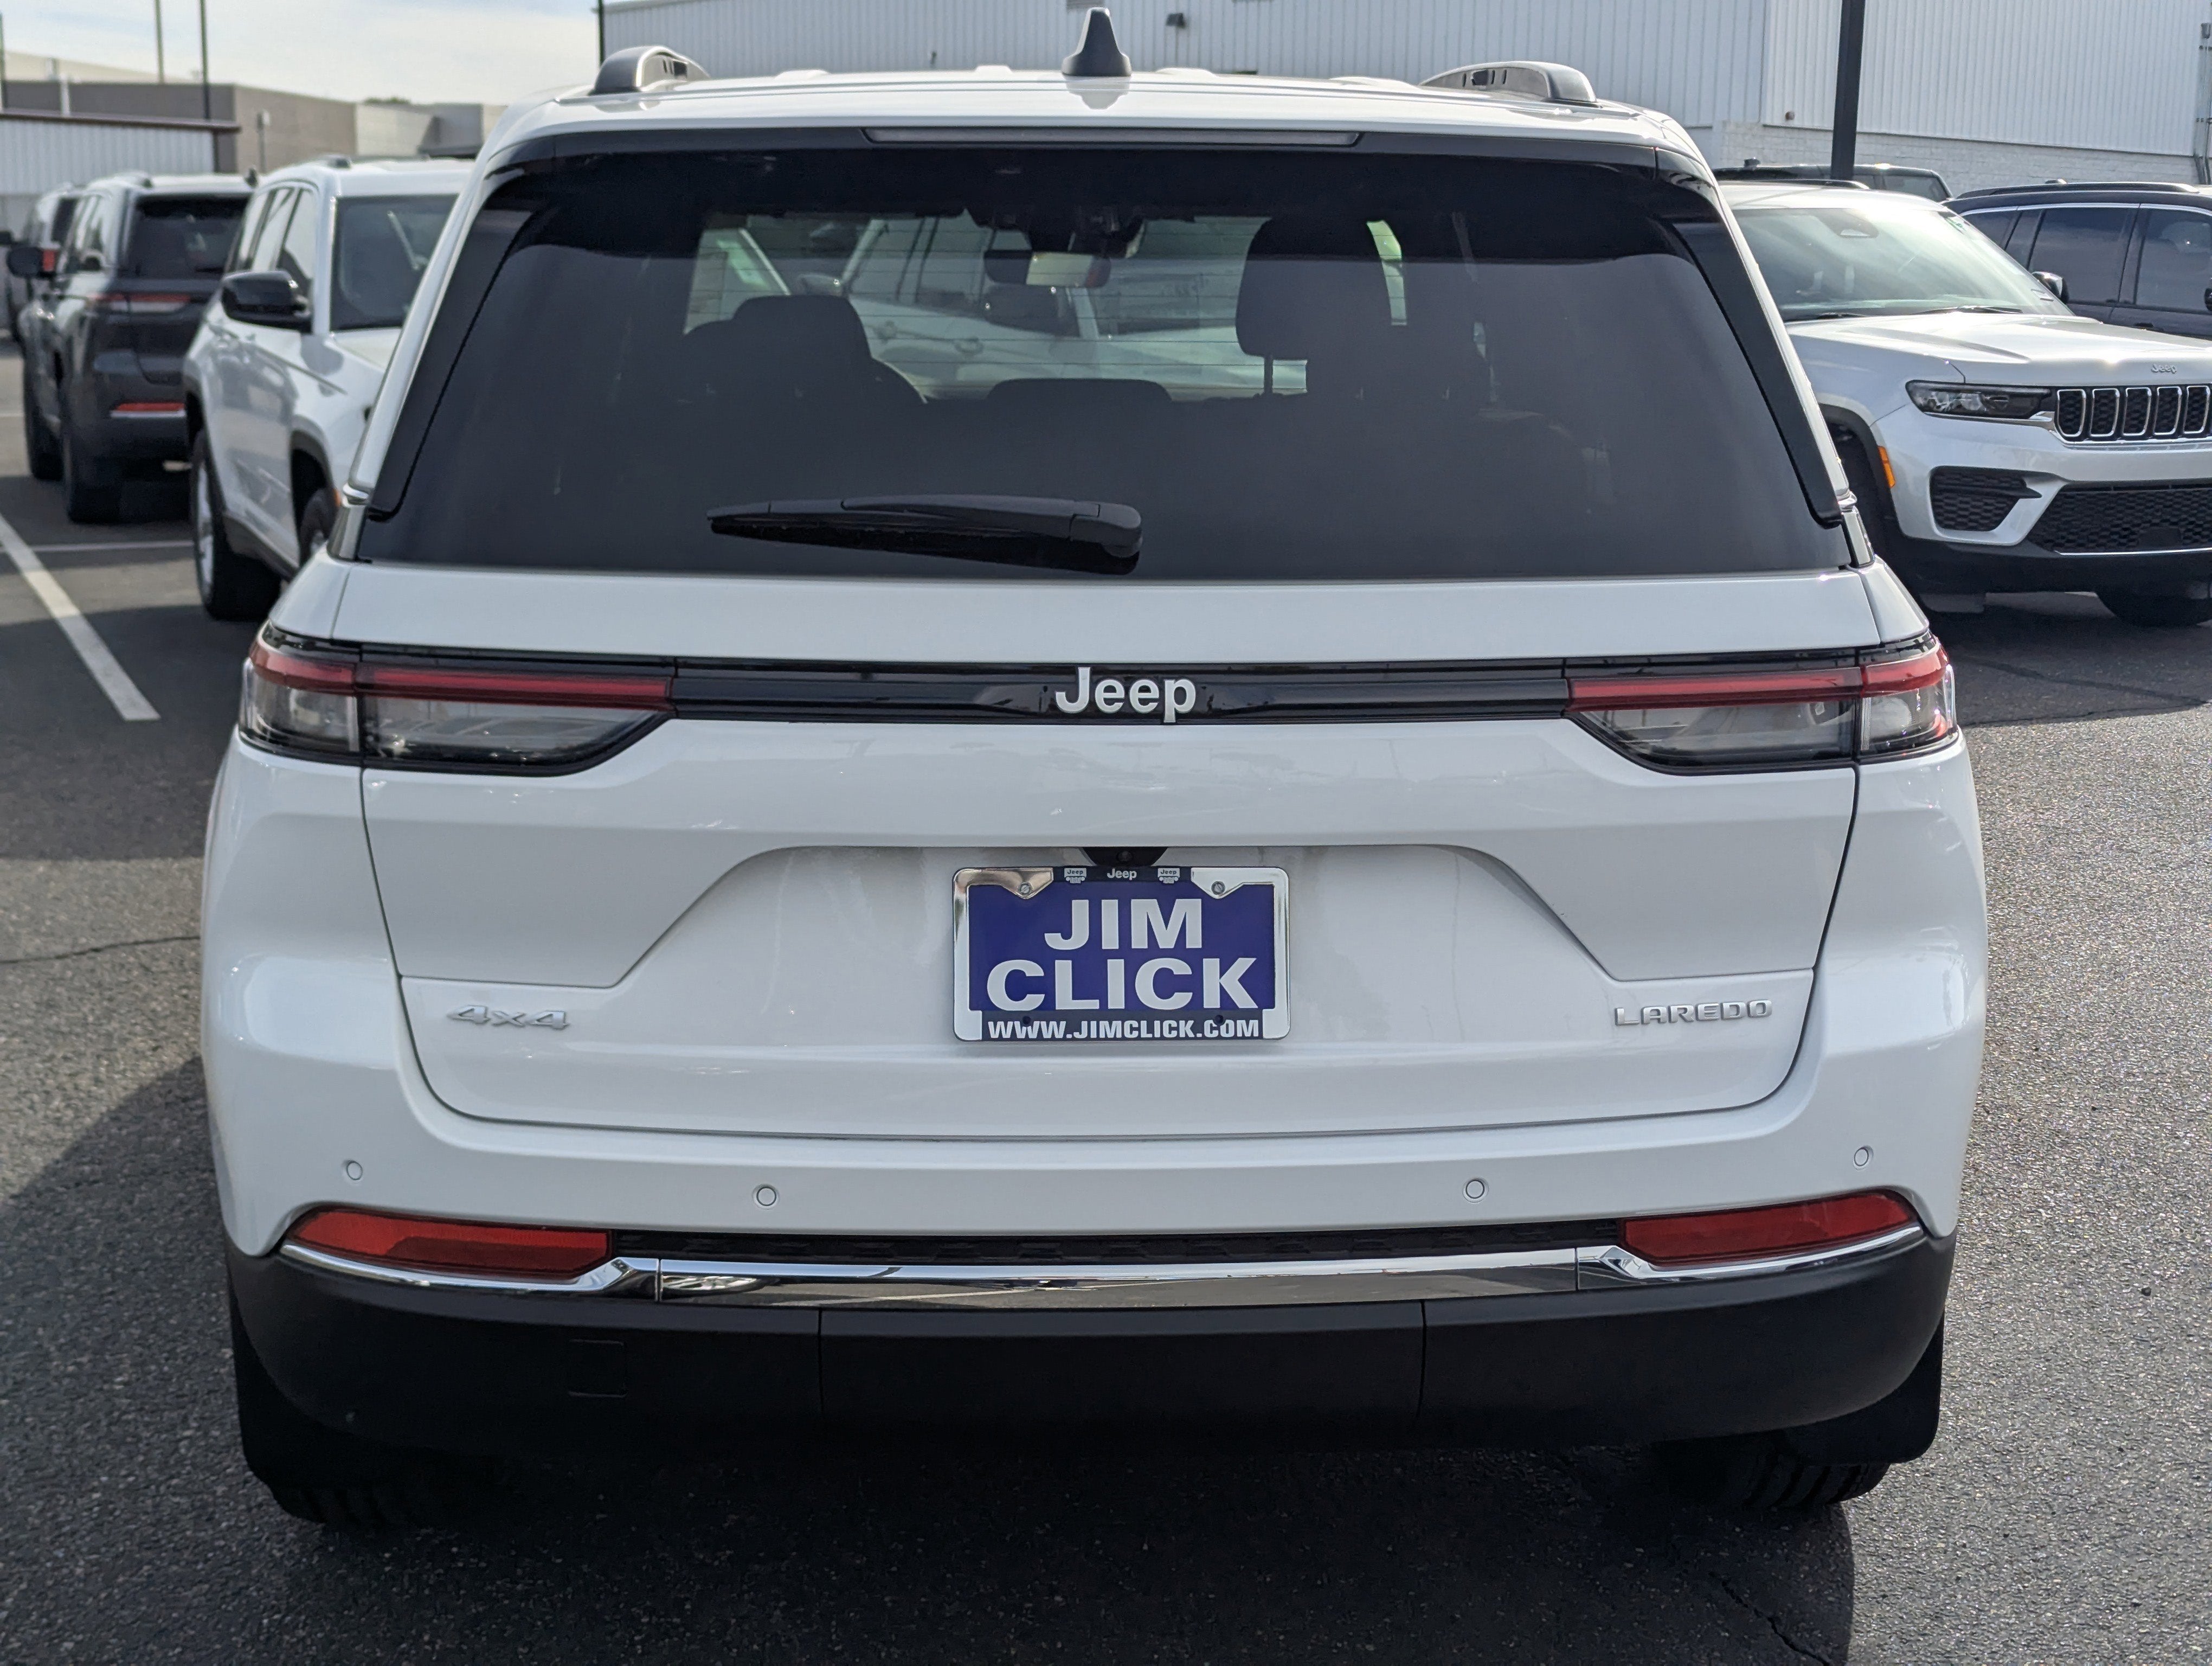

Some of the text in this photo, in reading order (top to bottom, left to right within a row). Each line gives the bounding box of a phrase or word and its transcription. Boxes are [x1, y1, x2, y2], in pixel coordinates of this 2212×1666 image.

[1055, 667, 1196, 723] Jeep
[1107, 868, 1137, 881] Jeep
[1044, 898, 1202, 950] JIM
[987, 957, 1258, 1011] CLICK
[447, 1004, 570, 1030] 4x4
[1615, 999, 1773, 1026] LAREDO
[988, 1019, 1259, 1039] WWW.JIMCLICK.COM
